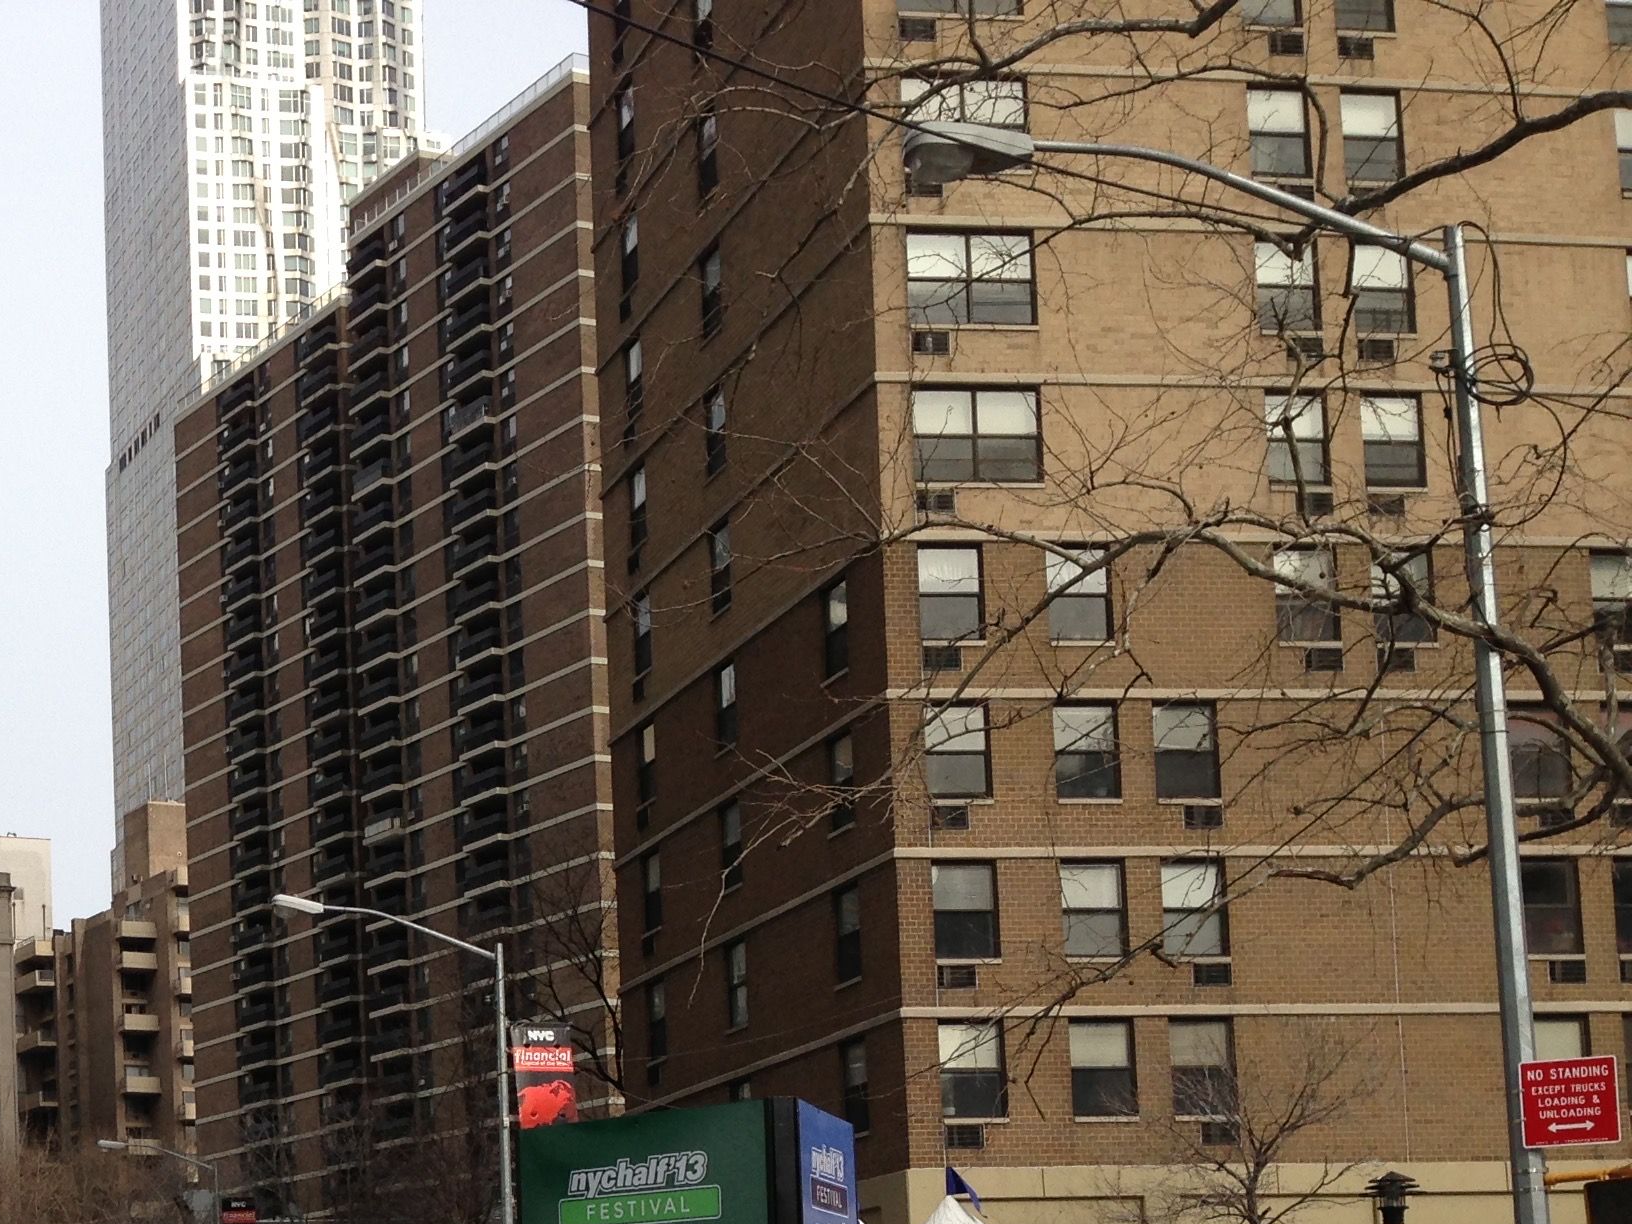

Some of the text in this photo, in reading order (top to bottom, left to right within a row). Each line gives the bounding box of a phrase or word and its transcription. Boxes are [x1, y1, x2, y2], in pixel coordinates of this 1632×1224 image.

[528, 1030, 555, 1041] NYC
[1527, 1065, 1609, 1081] NO STANDING
[1531, 1082, 1606, 1096] EXCEPT TRUCKS
[1538, 1094, 1600, 1108] LOADING &
[1539, 1107, 1601, 1119] UNLOADING
[816, 1185, 843, 1208] FESTIVAL
[586, 1196, 690, 1221] FESTIVAL
